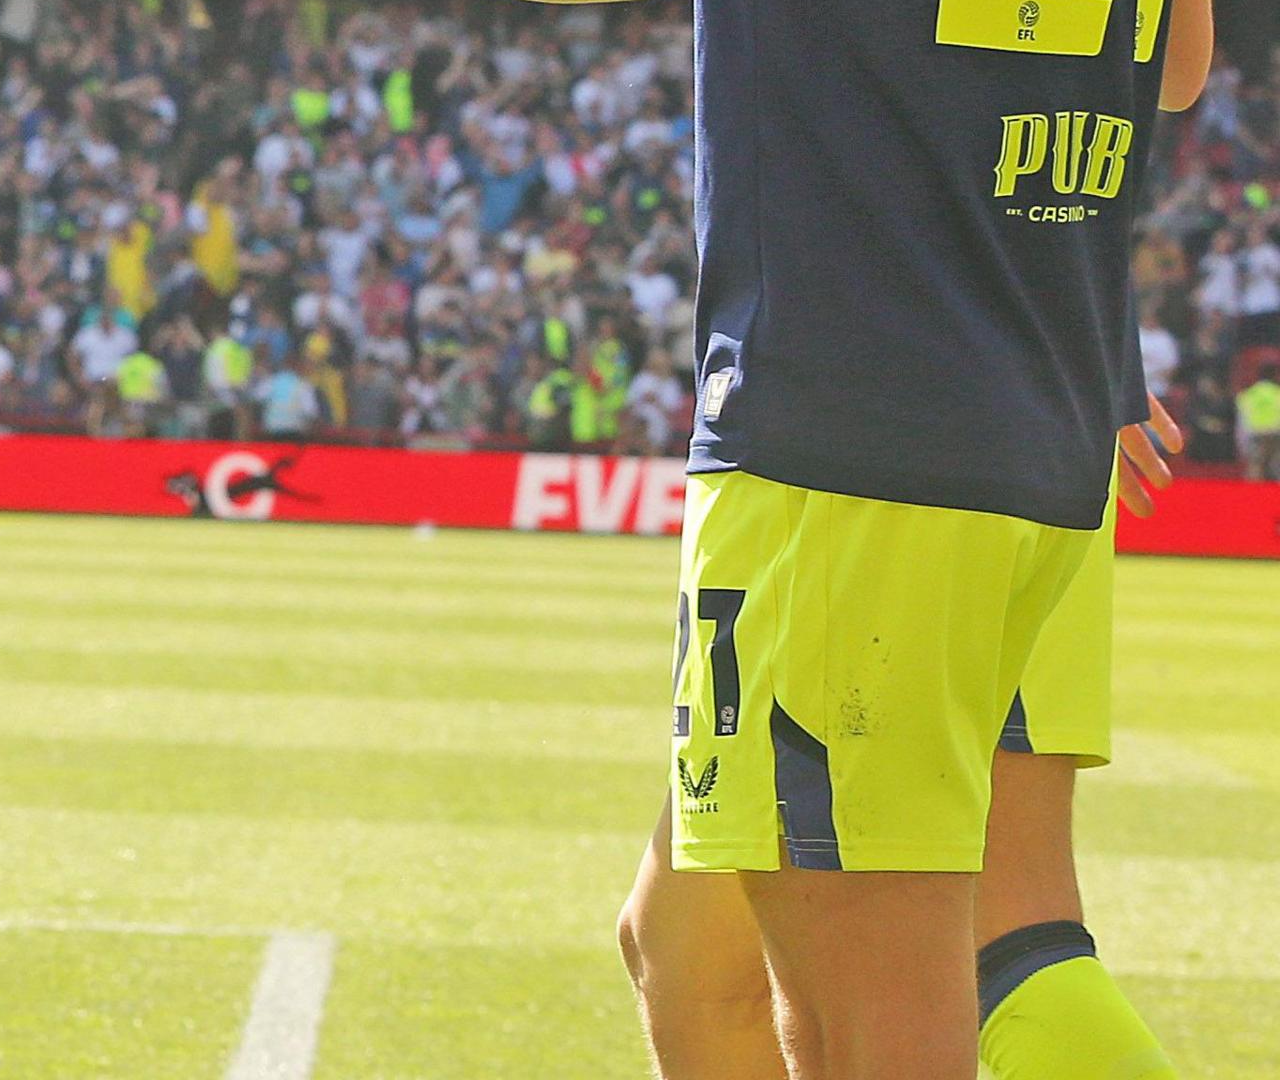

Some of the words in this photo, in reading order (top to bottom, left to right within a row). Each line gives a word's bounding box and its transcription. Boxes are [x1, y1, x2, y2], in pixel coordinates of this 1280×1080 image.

[1017, 29, 1036, 41] EFL
[993, 111, 1134, 199] PUB
[1028, 205, 1085, 223] CASINO
[513, 450, 686, 533] EVE
